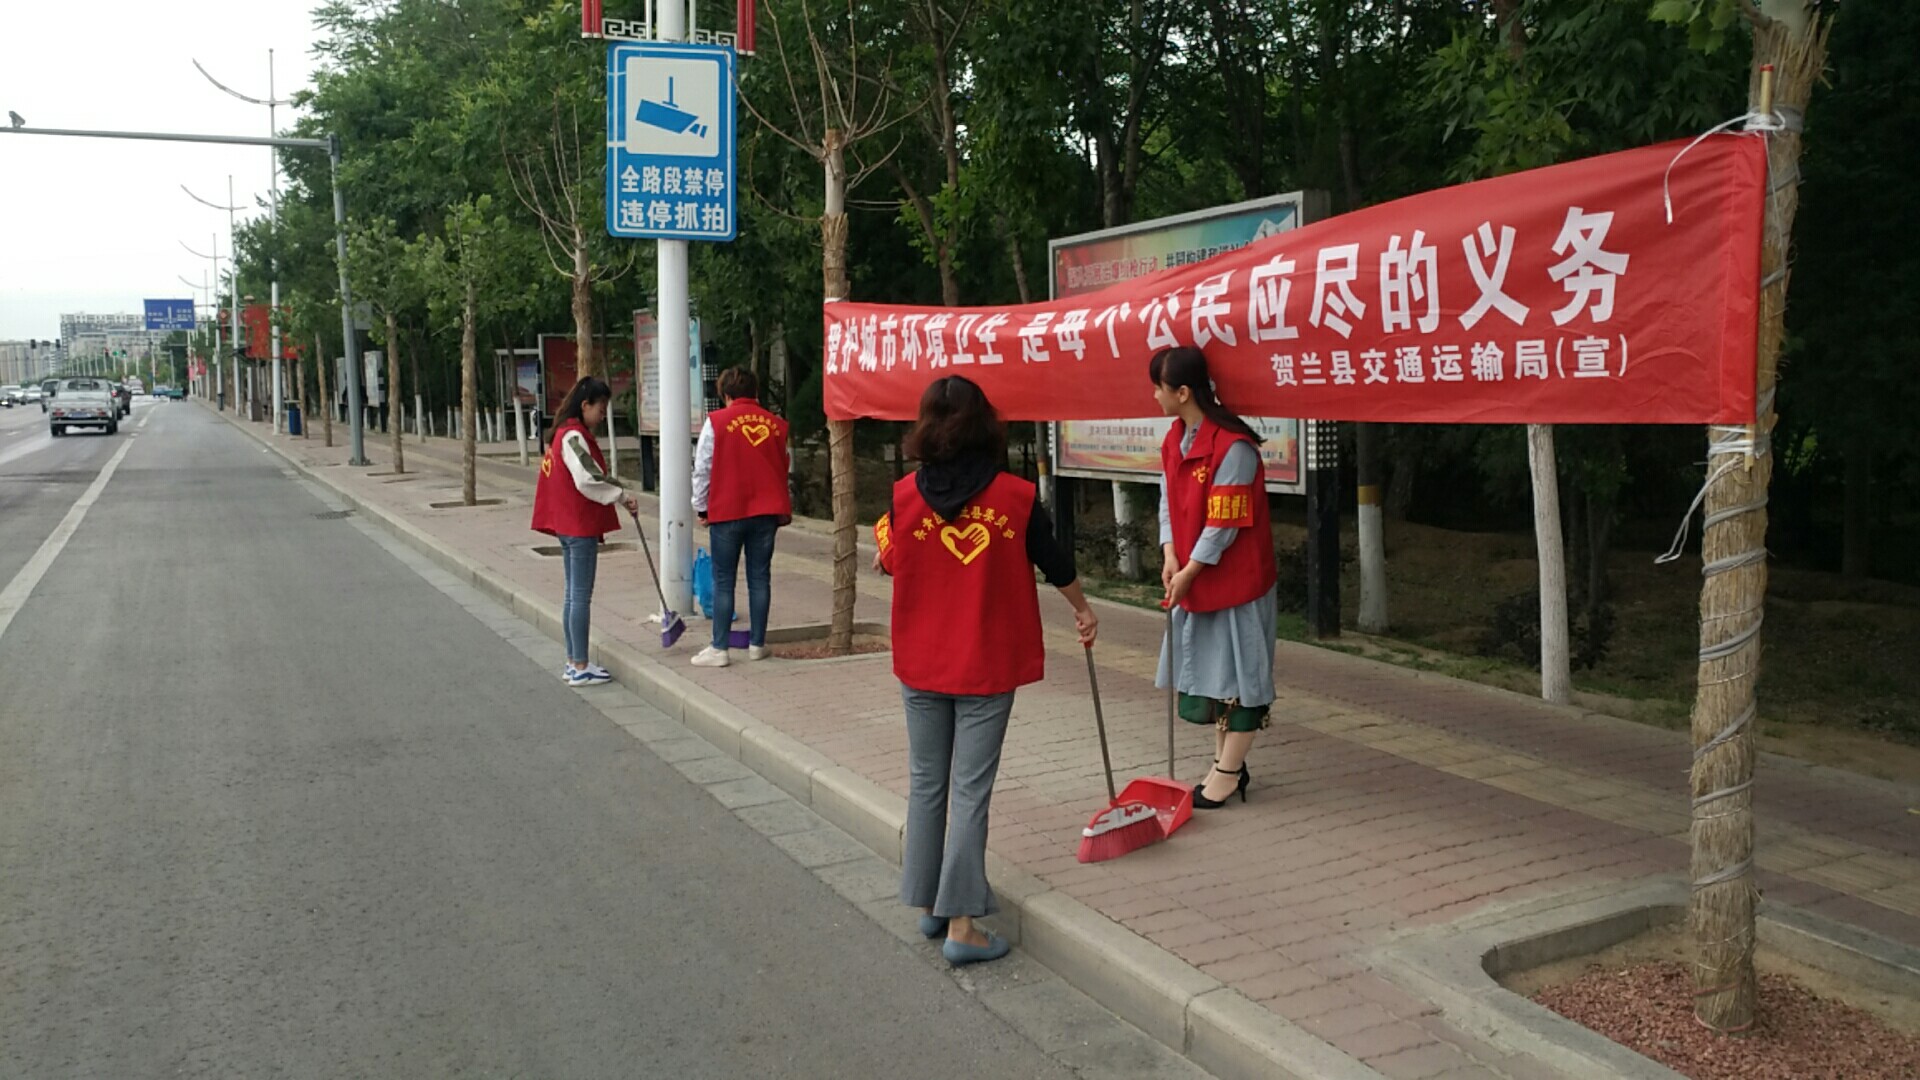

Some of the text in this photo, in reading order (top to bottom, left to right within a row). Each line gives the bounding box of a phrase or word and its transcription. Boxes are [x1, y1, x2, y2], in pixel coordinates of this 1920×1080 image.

[620, 164, 725, 197] 全路段禁停
[620, 199, 725, 231] 违停抓拍
[826, 206, 1630, 375] 爱护城市环境卫生 是每个公民应尽的义务
[1270, 333, 1628, 387] 贺兰县交通运输局(宣)
